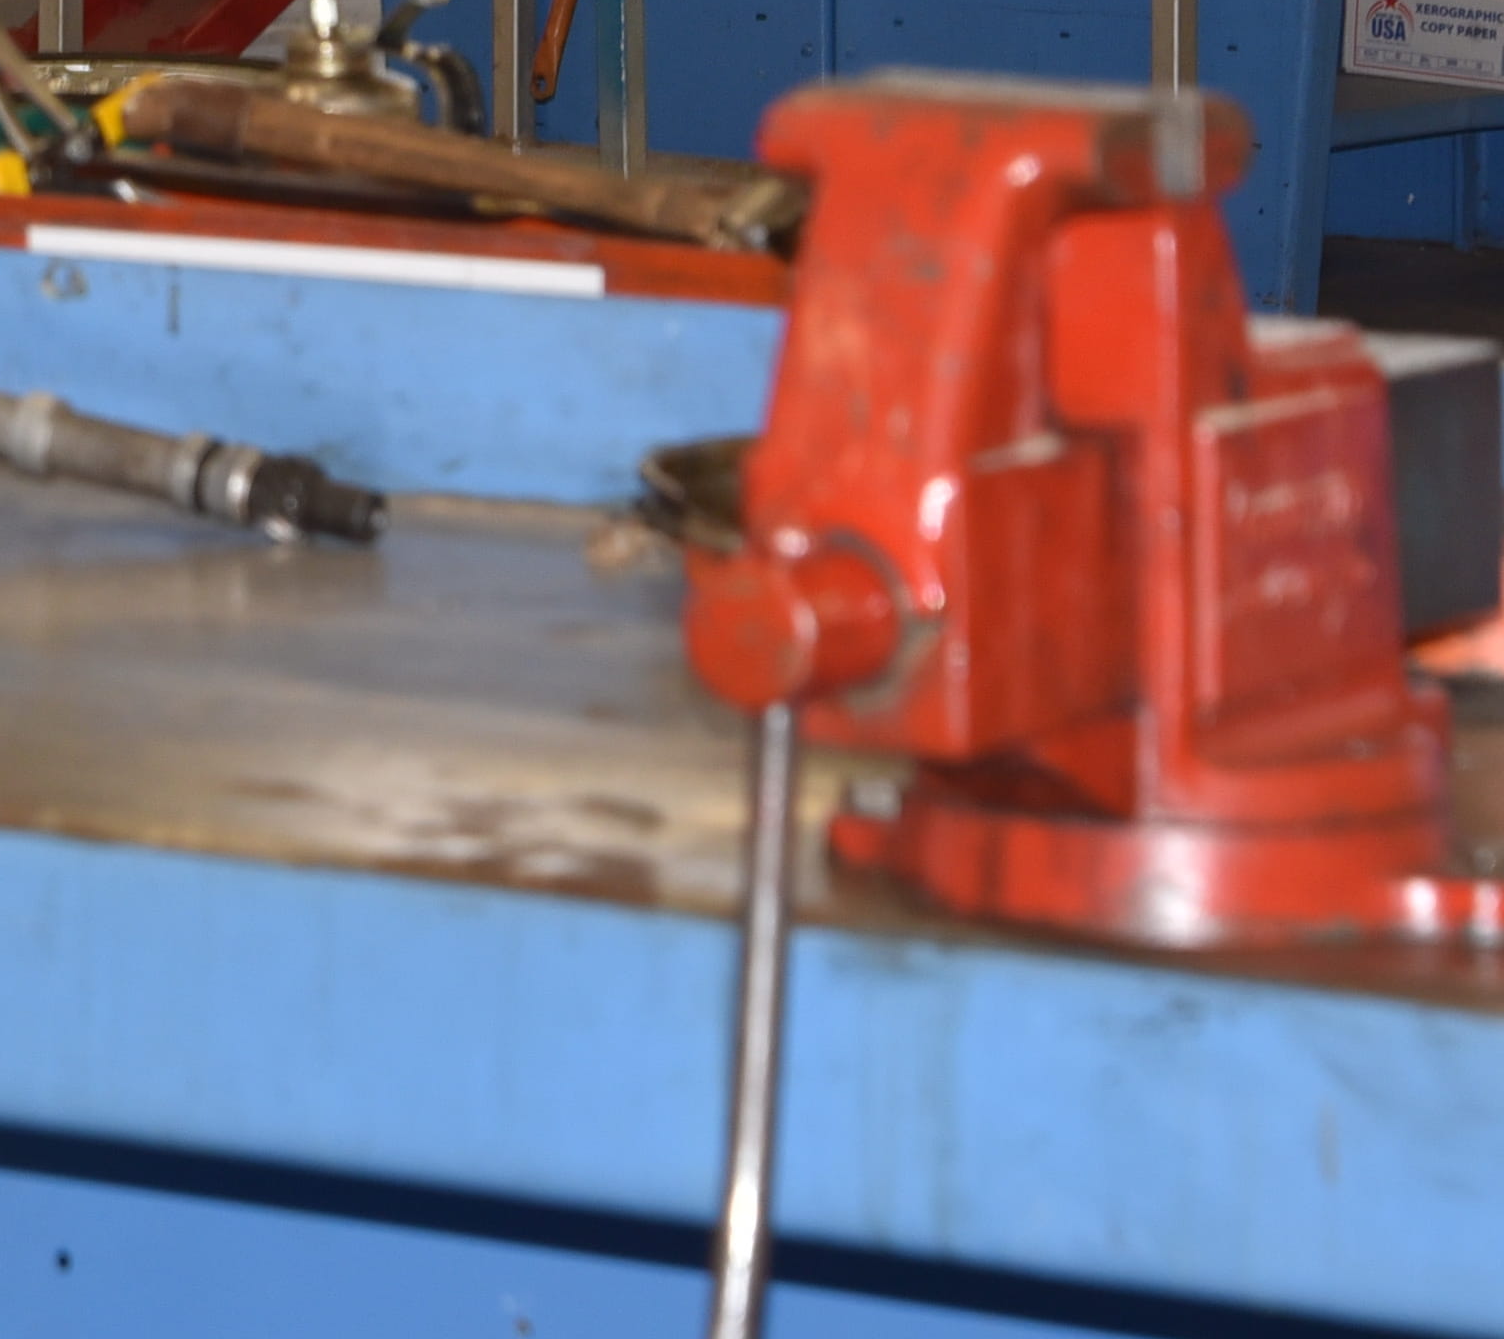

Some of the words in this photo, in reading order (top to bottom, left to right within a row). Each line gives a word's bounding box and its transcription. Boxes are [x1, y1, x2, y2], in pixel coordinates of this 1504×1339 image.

[1415, 2, 1504, 24] XEROGRAPHIC
[1371, 17, 1406, 42] USA
[1420, 21, 1454, 36] COPY
[1456, 26, 1498, 41] PAPER
